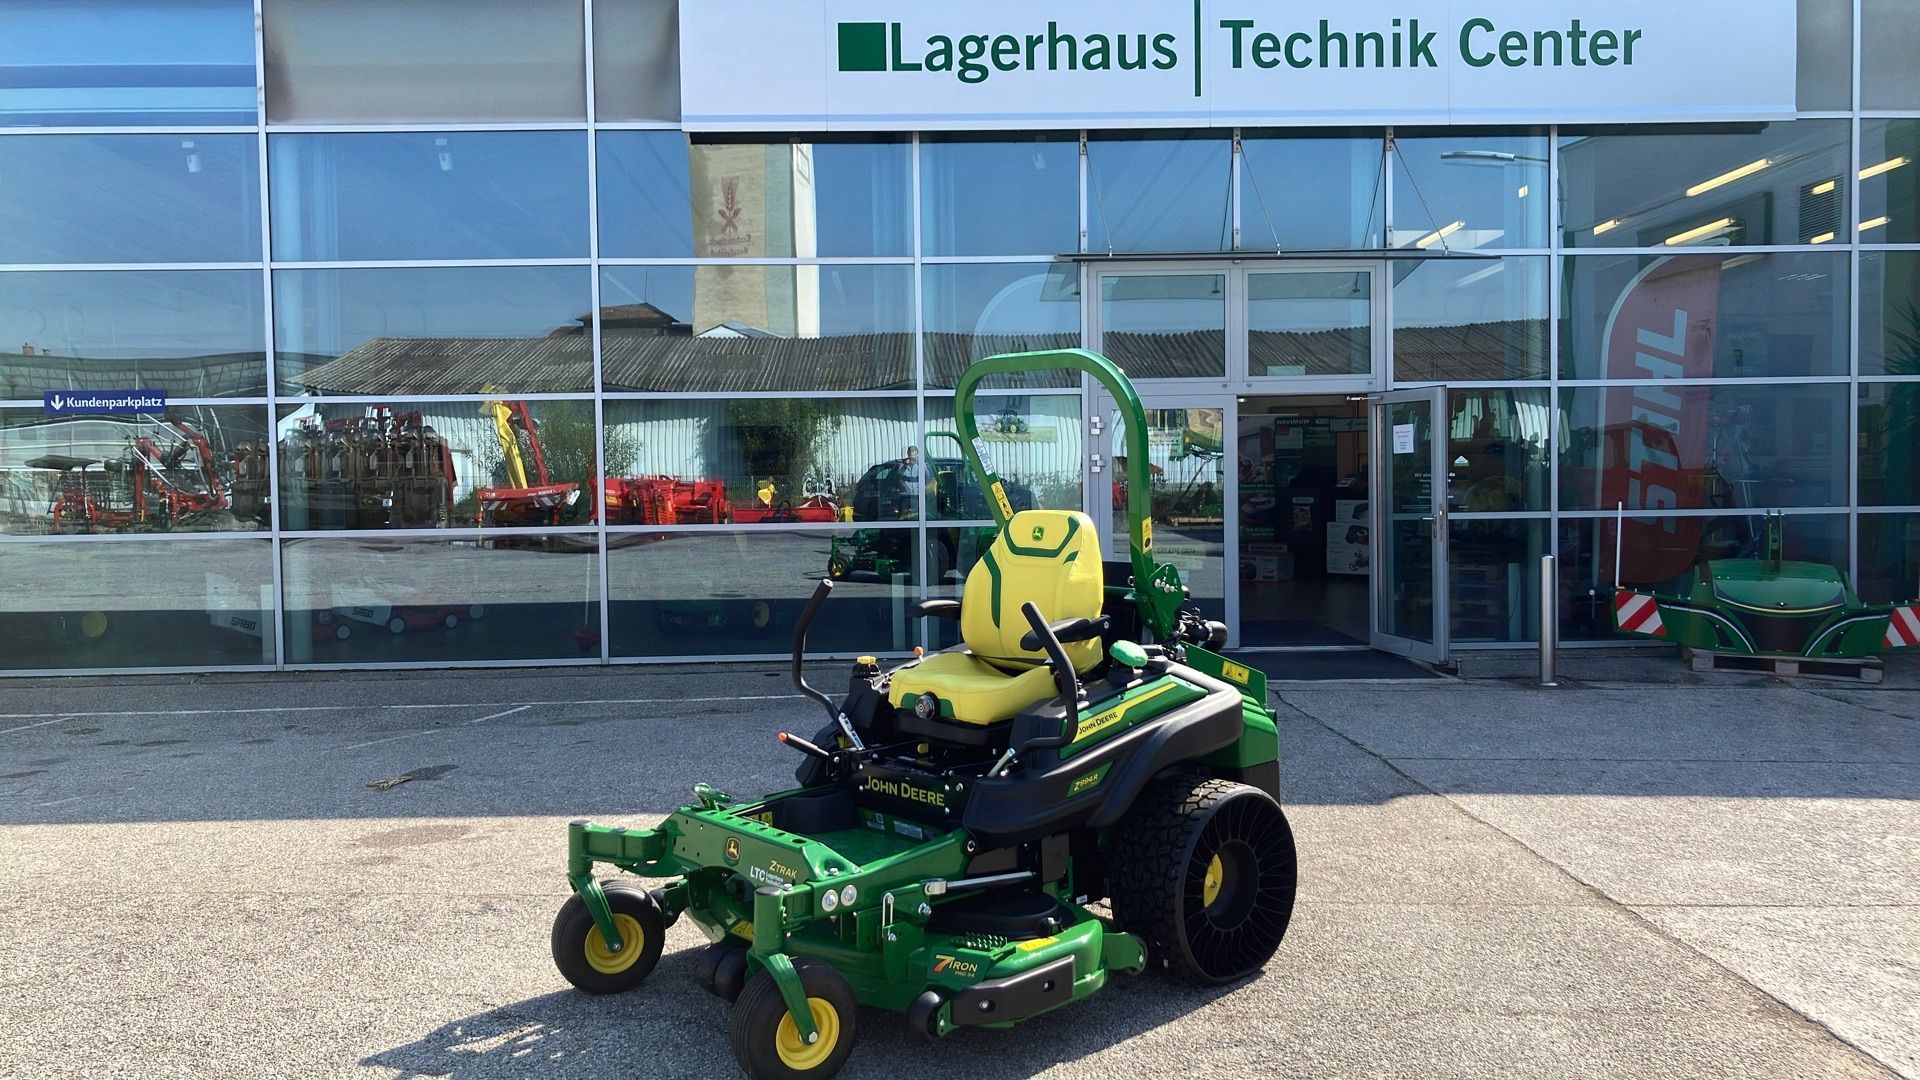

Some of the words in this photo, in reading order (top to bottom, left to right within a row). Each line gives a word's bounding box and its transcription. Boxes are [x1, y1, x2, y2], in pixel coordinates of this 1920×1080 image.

[891, 21, 1178, 84] Lagerhaus
[1219, 18, 1438, 69] Technik
[1459, 17, 1642, 67] Center
[66, 396, 163, 410] Kundenparkplatz
[1627, 308, 1688, 534] STIHL
[231, 616, 256, 631] SABO
[1079, 721, 1096, 735] JOHN
[1096, 712, 1118, 726] DEERE
[864, 775, 898, 796] JOHN
[900, 782, 945, 807] DEERE
[749, 865, 766, 882] LTC
[769, 859, 798, 879] ZTRAK
